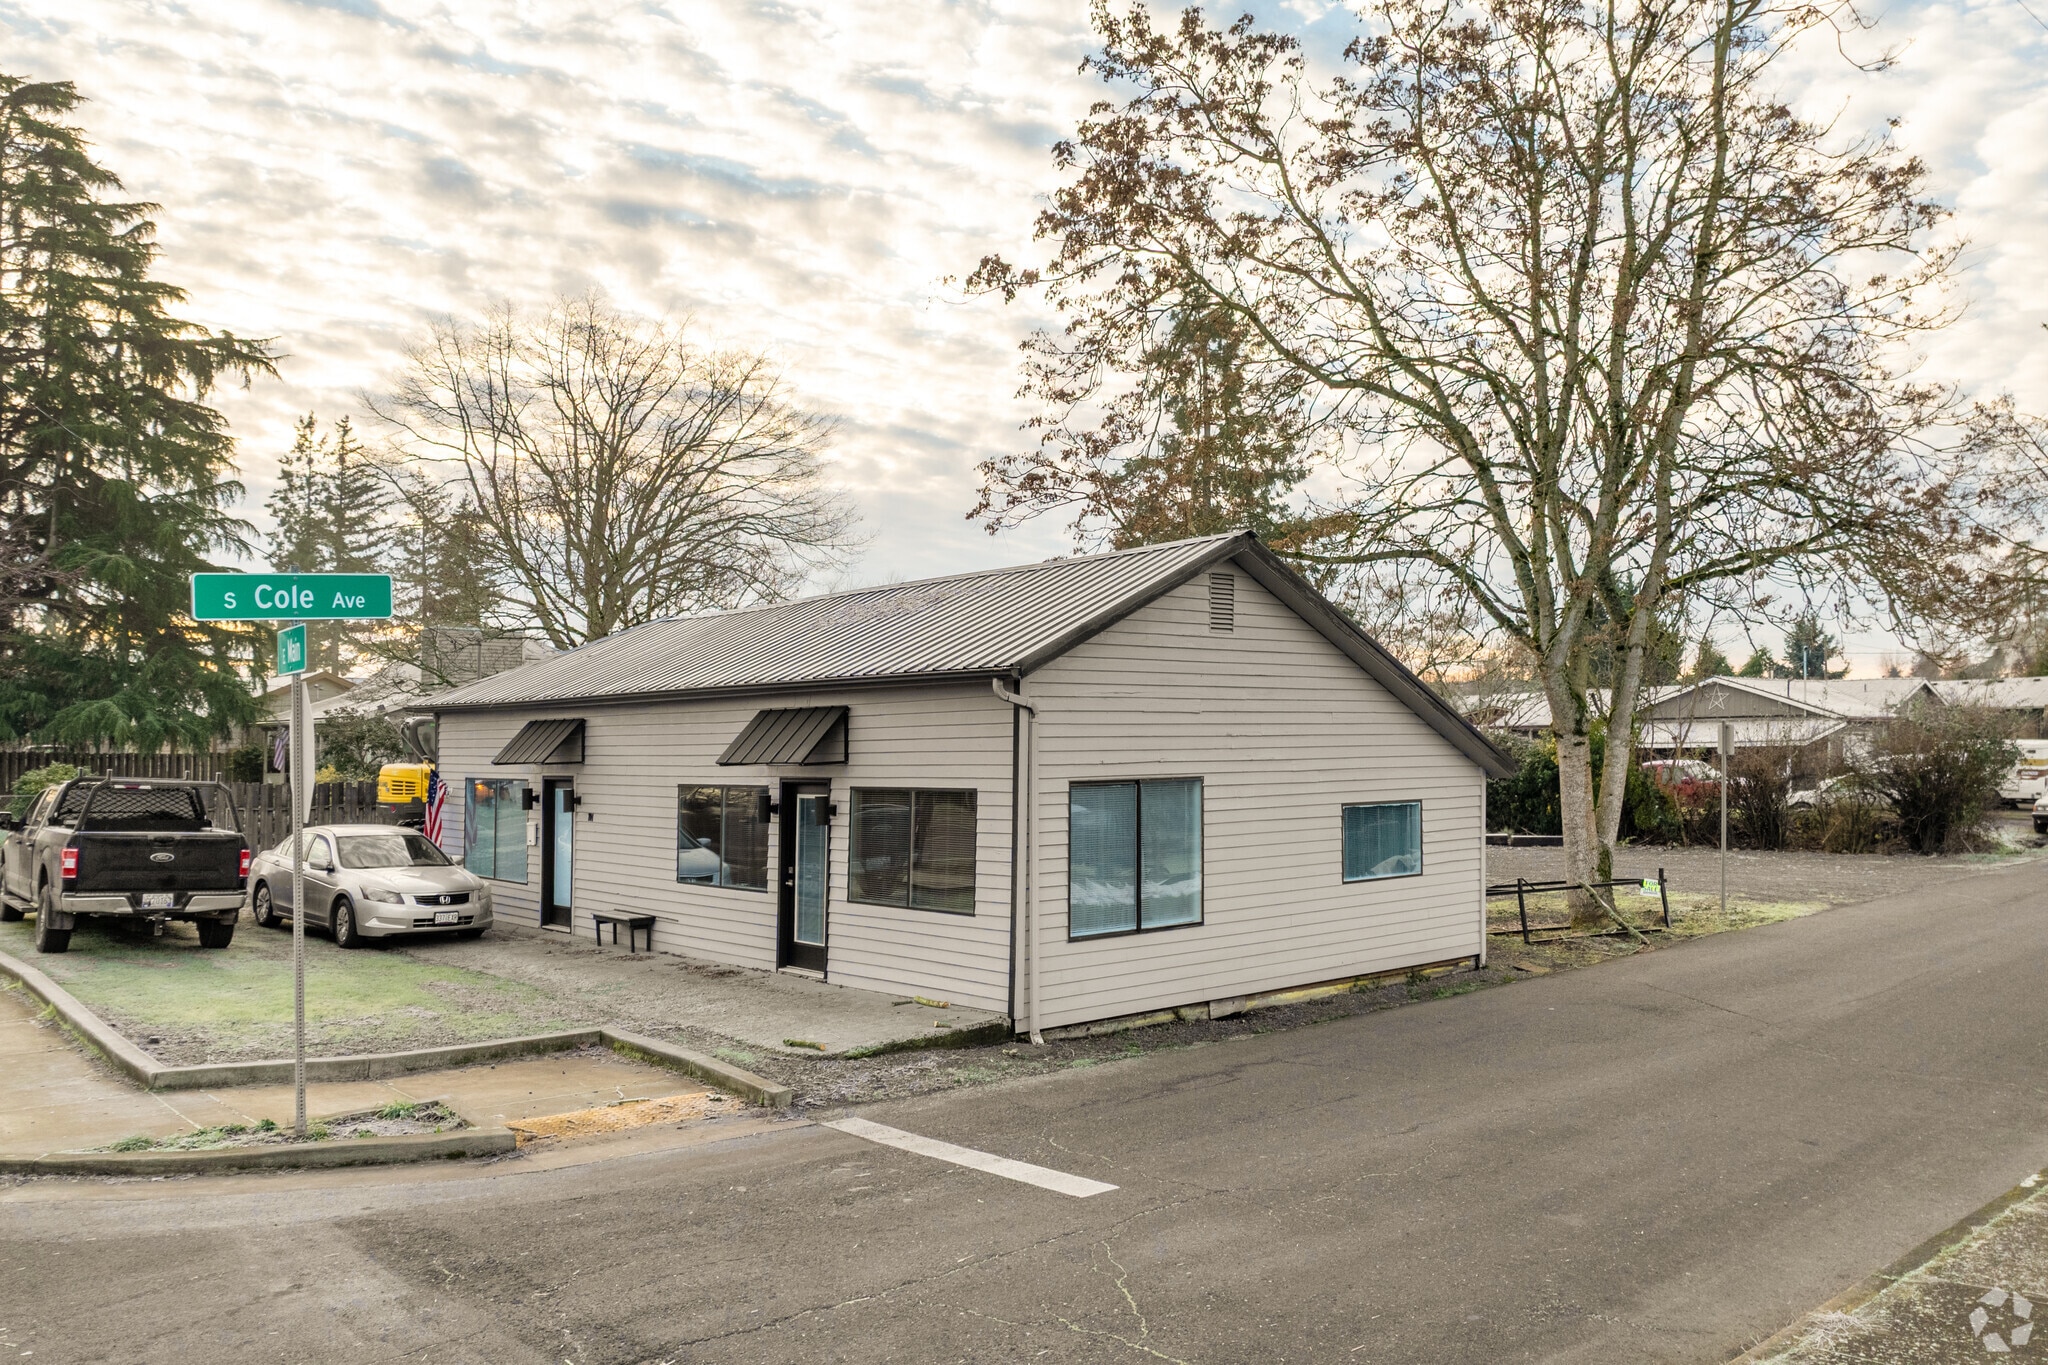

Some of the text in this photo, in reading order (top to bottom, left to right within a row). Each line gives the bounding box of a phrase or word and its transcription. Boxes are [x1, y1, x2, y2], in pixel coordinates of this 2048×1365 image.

[224, 584, 366, 609] S Cole Ave
